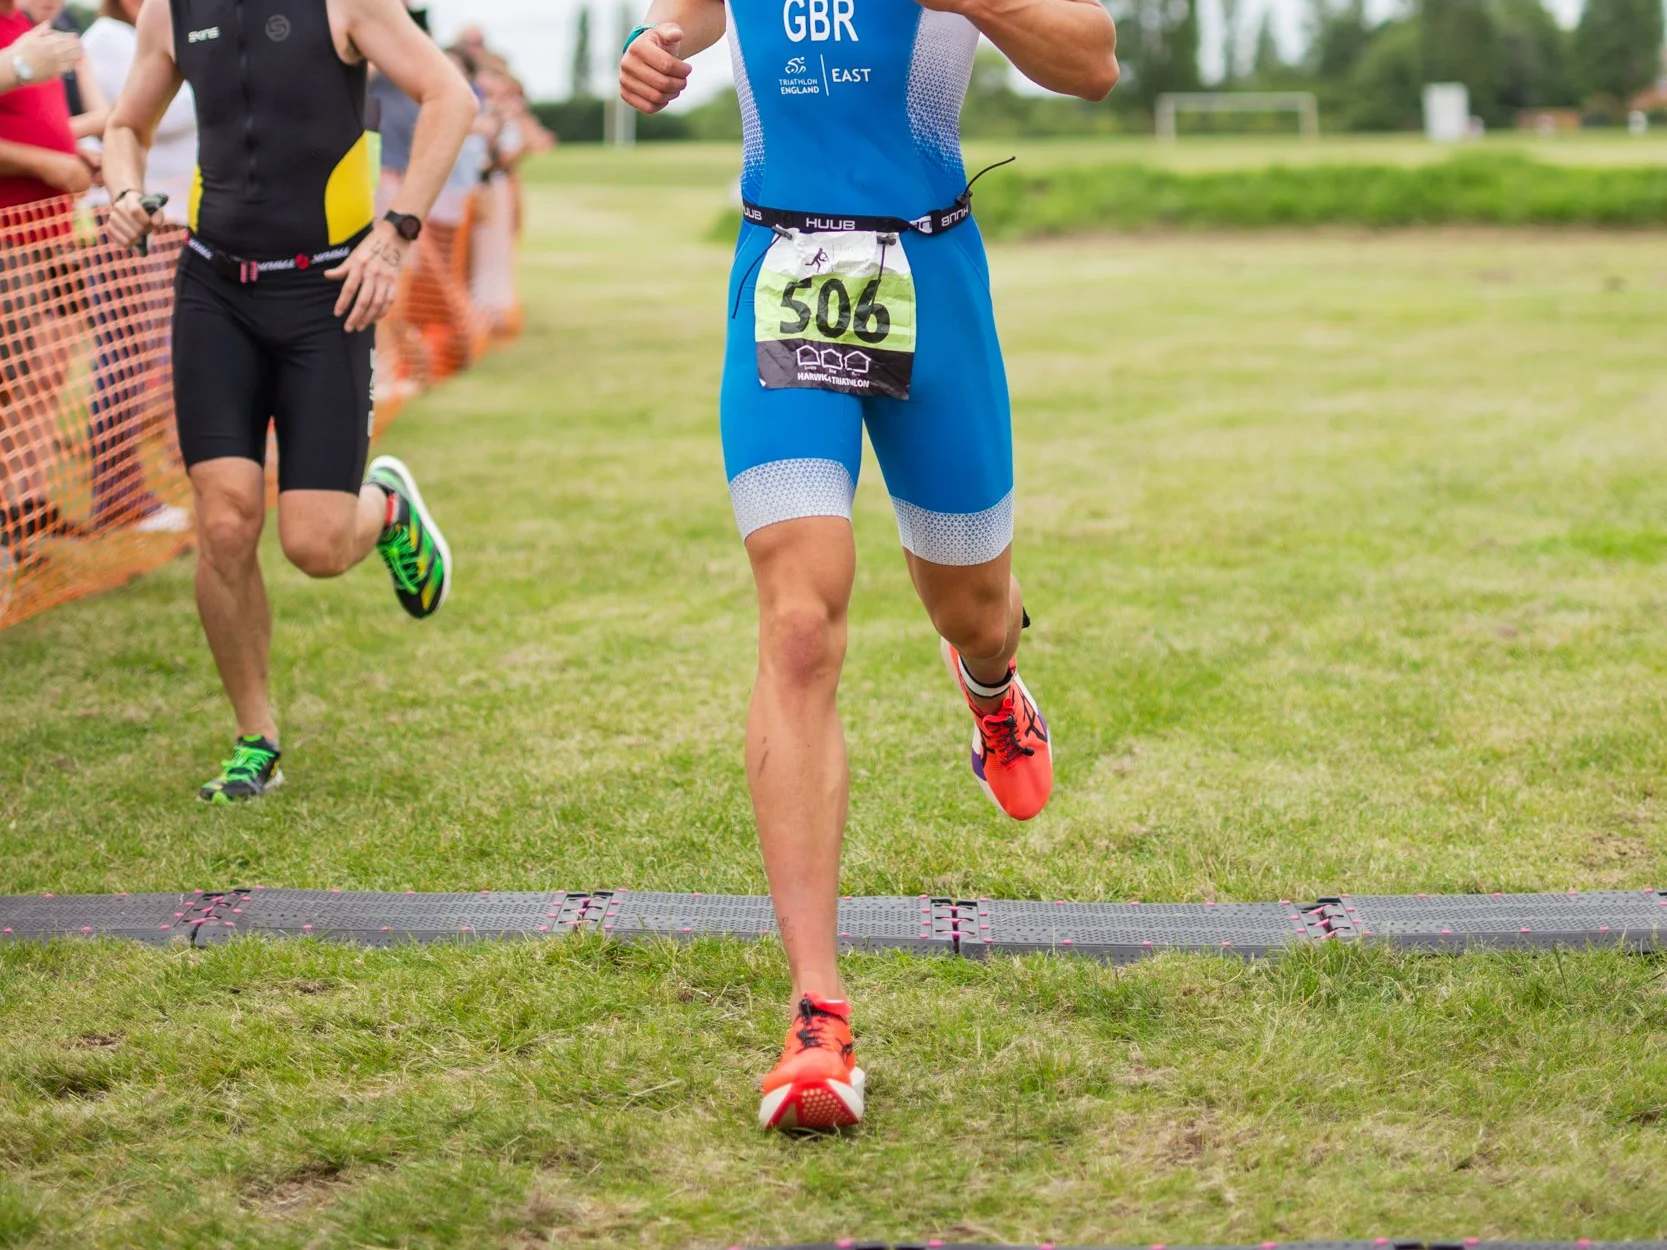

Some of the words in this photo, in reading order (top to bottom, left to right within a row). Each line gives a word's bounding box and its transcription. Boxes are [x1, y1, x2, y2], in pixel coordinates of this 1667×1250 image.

[779, 78, 819, 86] TRIATHLON
[831, 68, 872, 83] EAST
[780, 85, 820, 95] ENGLAND
[743, 206, 762, 221] UUB
[805, 217, 856, 231] HUUB
[779, 277, 891, 344] 506
